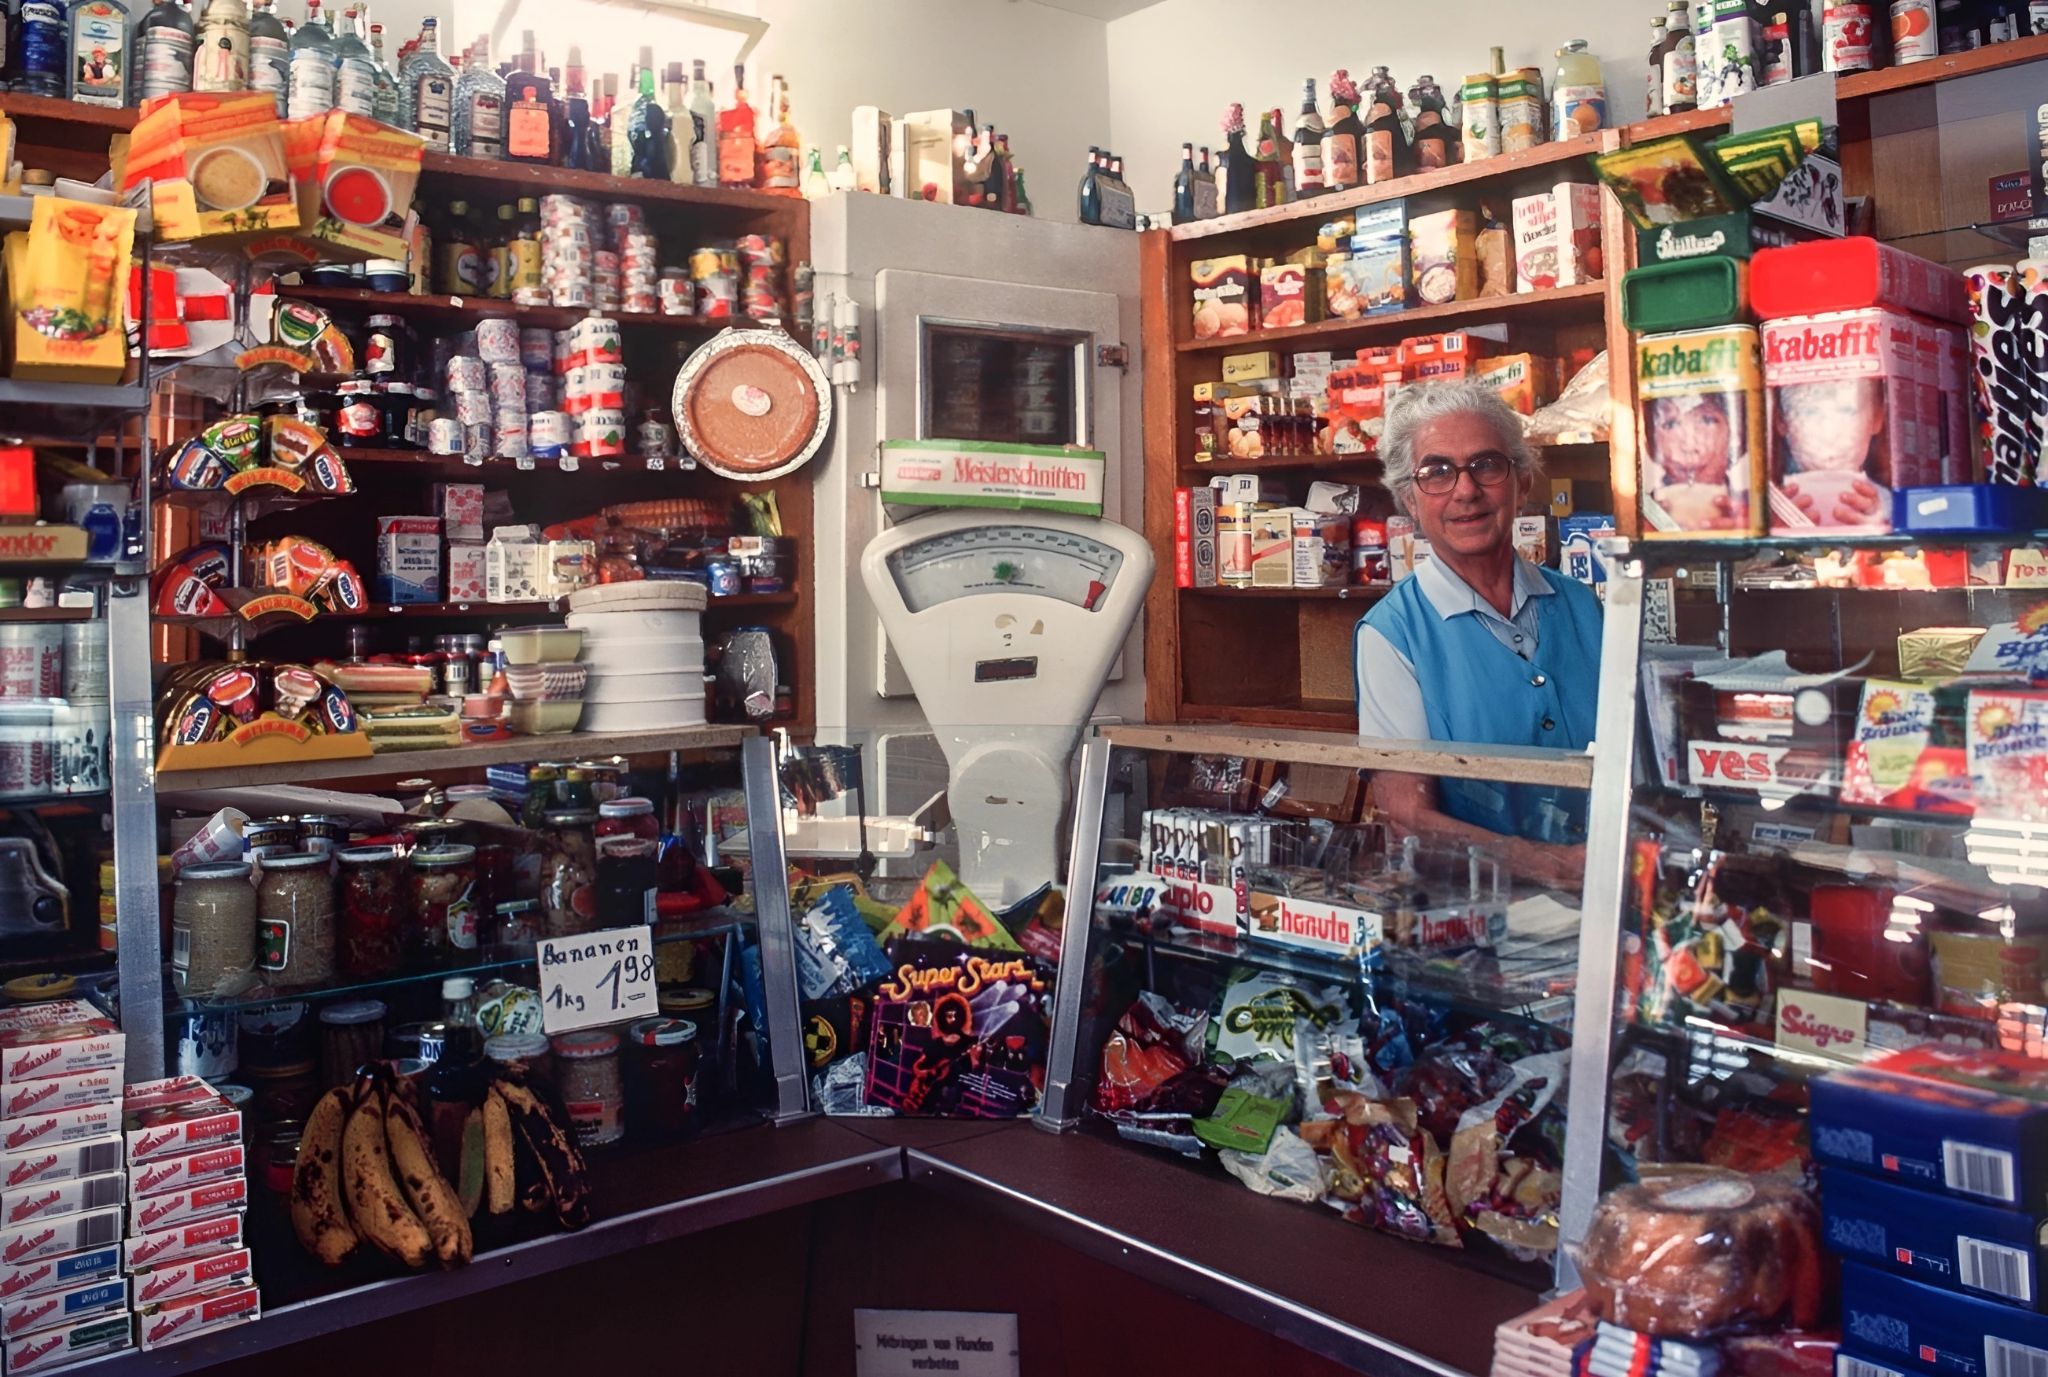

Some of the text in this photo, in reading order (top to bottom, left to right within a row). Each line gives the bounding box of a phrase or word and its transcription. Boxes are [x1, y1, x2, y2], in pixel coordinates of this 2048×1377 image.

[1640, 337, 1740, 378] kabafit
[1765, 321, 1881, 364] kabafit
[953, 456, 1087, 490] Meisterschnitten
[1161, 882, 1214, 919] uplo
[1281, 901, 1350, 945] hanuta
[542, 939, 639, 965] Bananen
[880, 957, 1045, 1001] Super Stars
